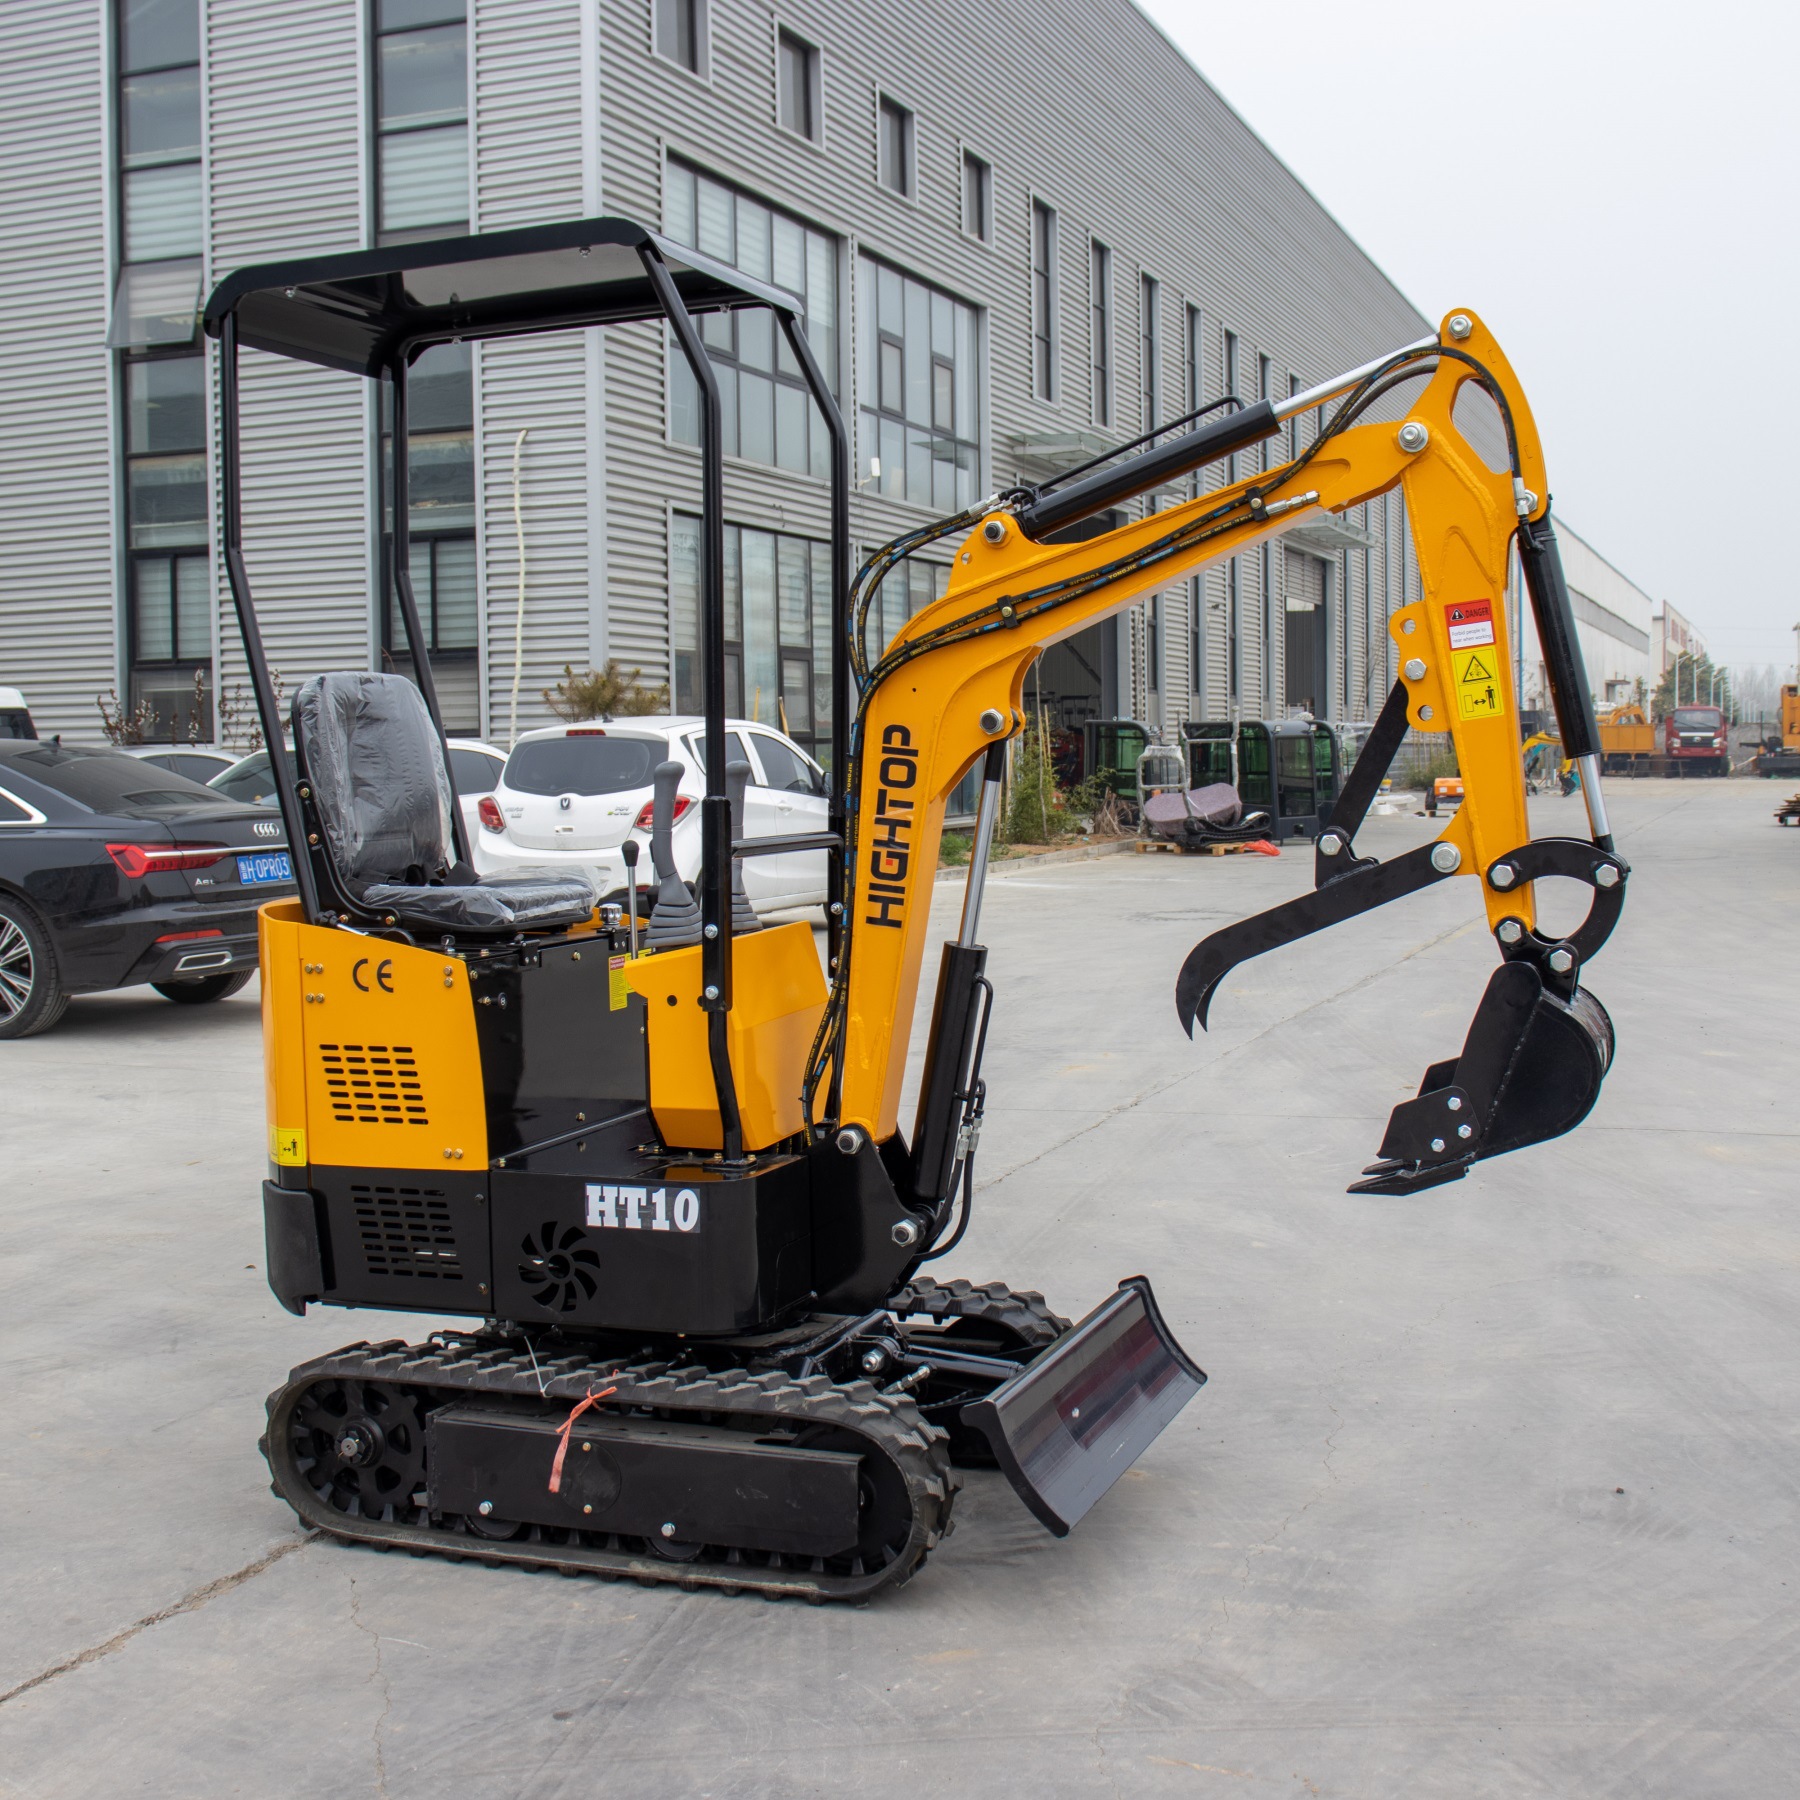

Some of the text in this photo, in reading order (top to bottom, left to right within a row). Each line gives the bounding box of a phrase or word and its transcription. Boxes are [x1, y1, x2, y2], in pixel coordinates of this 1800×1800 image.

[1107, 563, 1138, 580] YONGJIE
[1465, 607, 1489, 618] DANGER
[865, 724, 919, 929] HIGHTOP
[353, 958, 394, 993] CE
[586, 1185, 699, 1231] HT10
